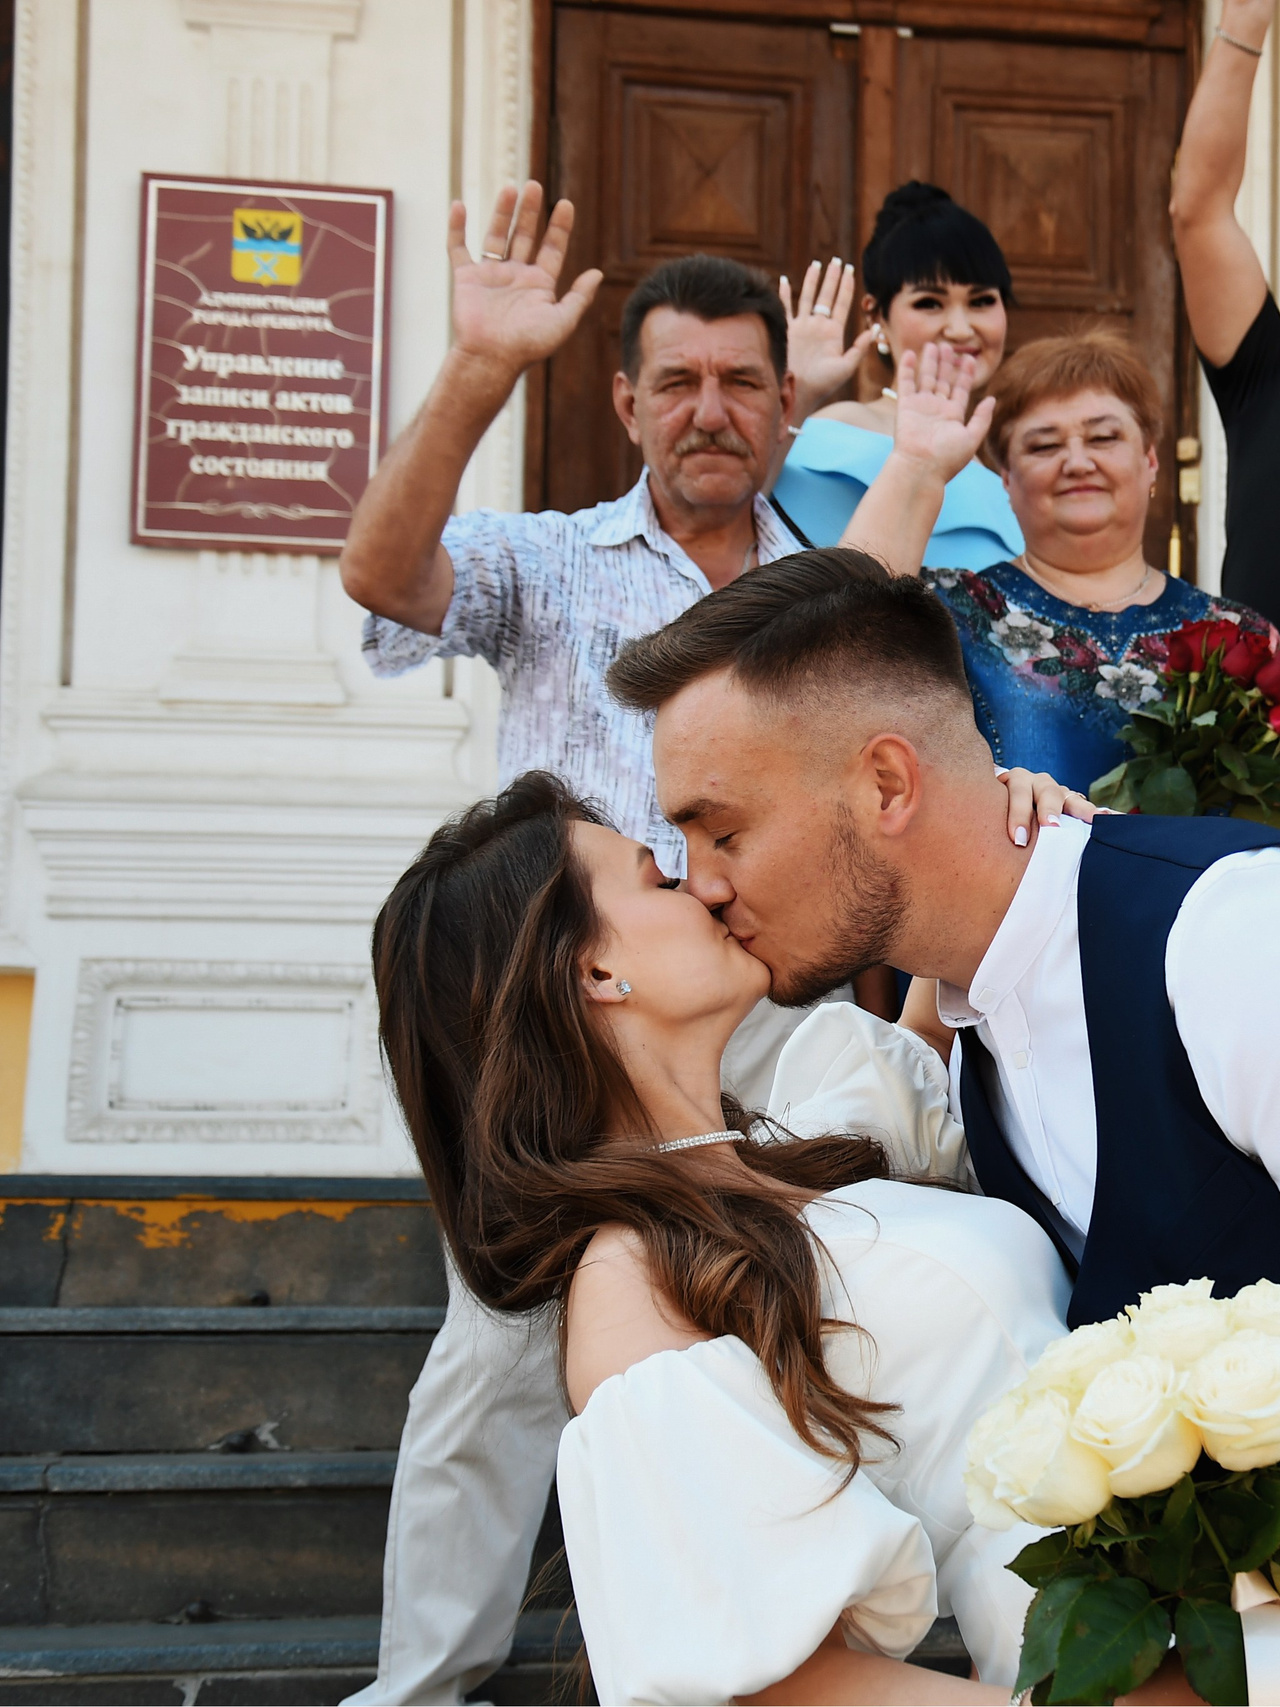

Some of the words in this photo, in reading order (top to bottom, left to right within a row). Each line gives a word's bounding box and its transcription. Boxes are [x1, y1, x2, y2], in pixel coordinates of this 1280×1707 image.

[183, 345, 345, 380] Управление
[177, 385, 270, 409] записи
[275, 390, 354, 415] актов
[166, 418, 355, 449] гражданского
[189, 454, 329, 481] состояния
